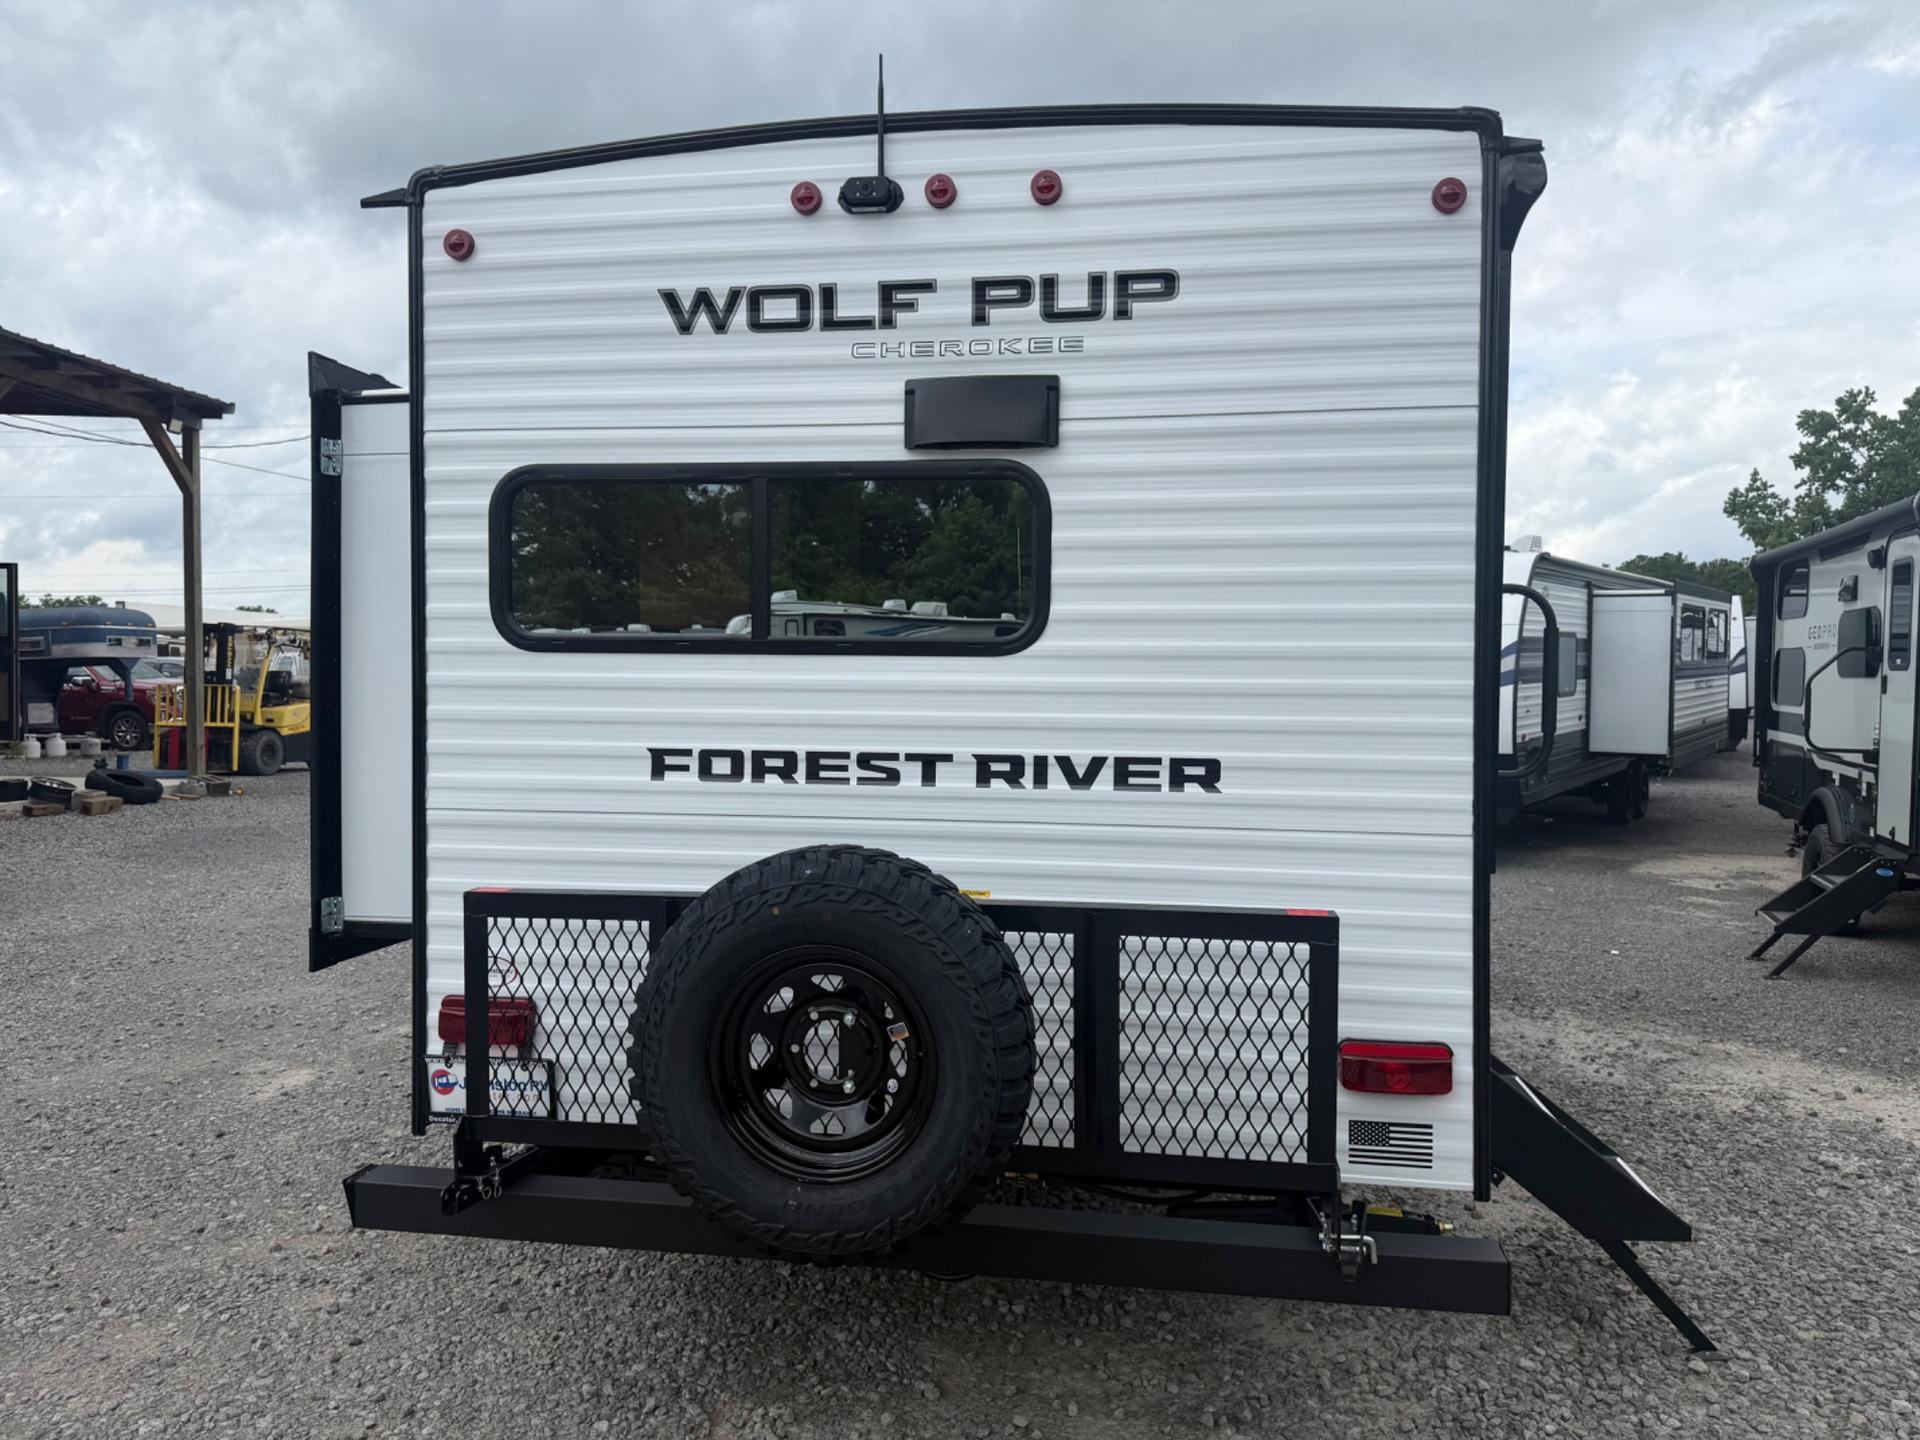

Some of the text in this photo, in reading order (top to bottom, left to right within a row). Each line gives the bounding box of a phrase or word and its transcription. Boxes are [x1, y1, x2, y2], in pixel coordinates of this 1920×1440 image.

[658, 268, 1180, 336] WOLF PUP
[851, 335, 1085, 359] CHEROKEE
[646, 747, 1223, 794] FOREST RIVER
